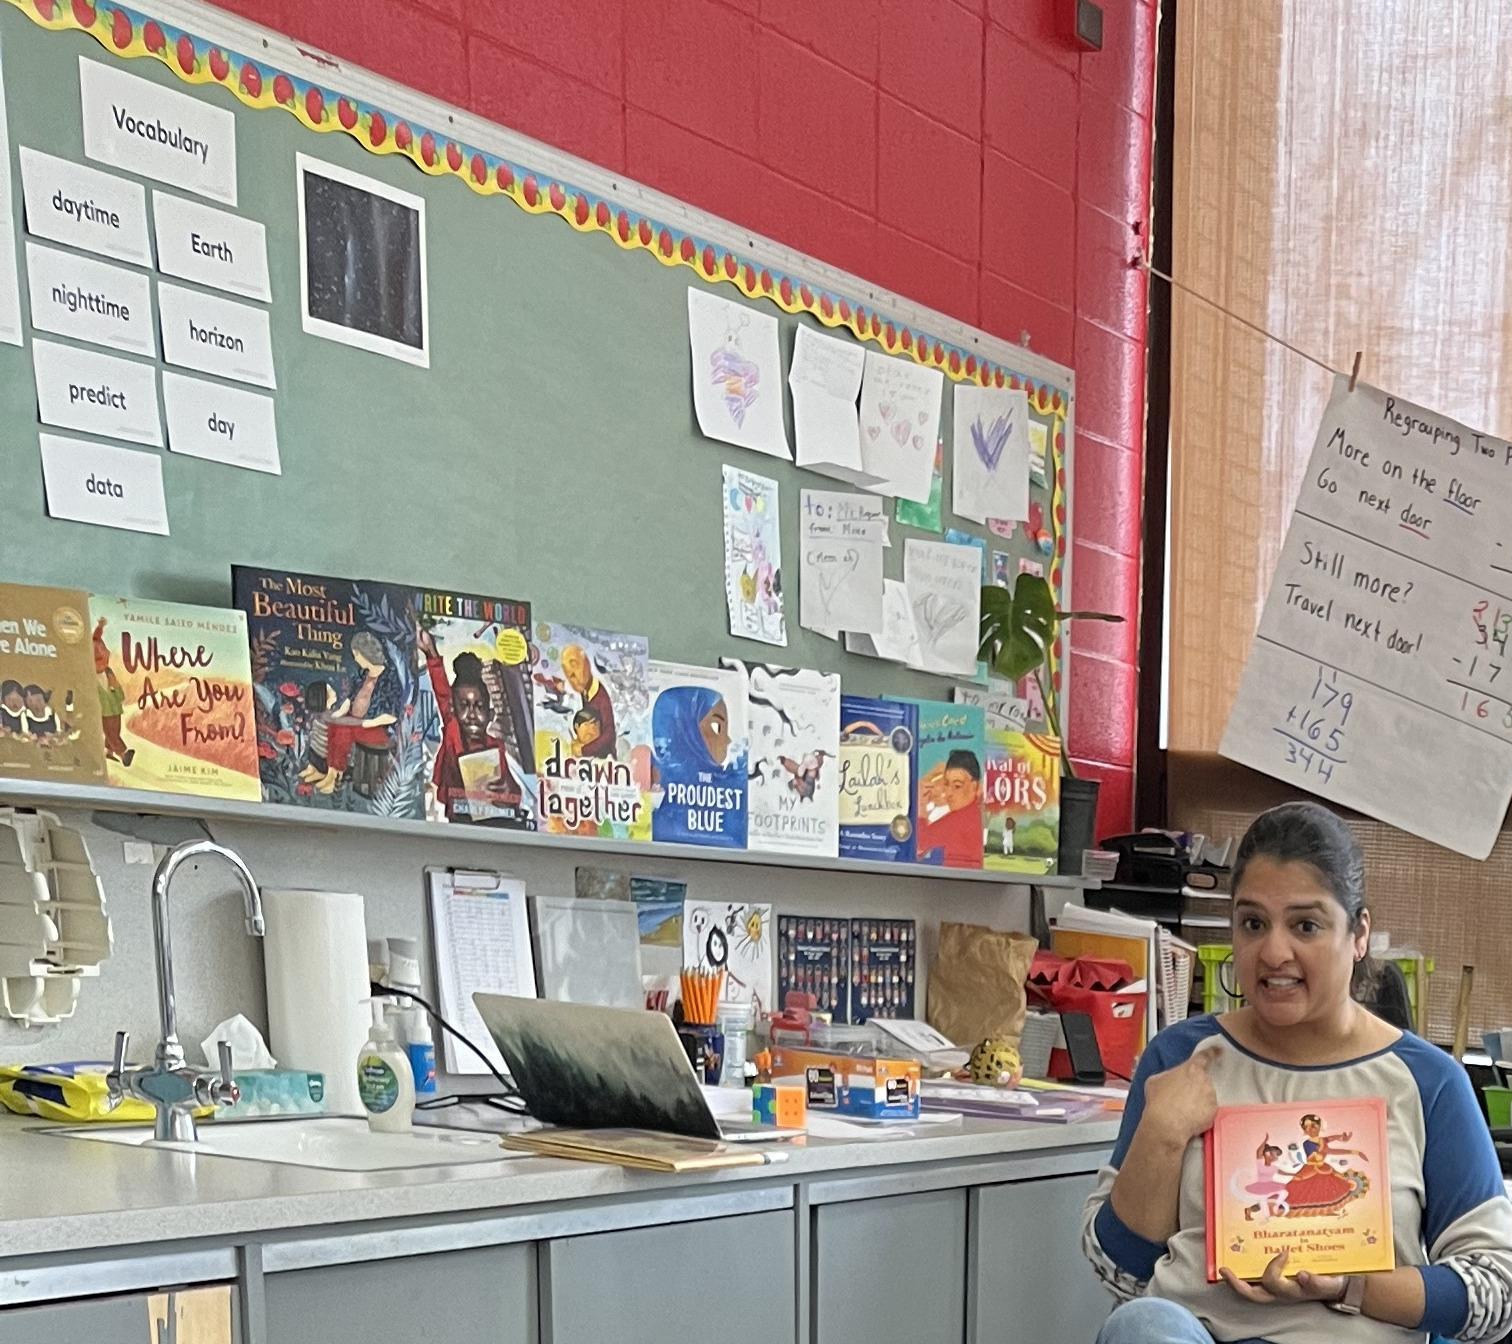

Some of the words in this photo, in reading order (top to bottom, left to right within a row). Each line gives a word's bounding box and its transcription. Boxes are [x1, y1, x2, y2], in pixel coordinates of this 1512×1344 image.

[112, 105, 209, 164] Vocabulary
[52, 190, 120, 230] daytime
[191, 234, 233, 263] Earth
[52, 285, 130, 323] nighttime
[189, 320, 244, 354] horizon
[68, 381, 127, 412] predict
[208, 413, 235, 440] day
[1384, 398, 1460, 456] Regrouping
[1472, 433, 1494, 458] Two
[1328, 428, 1370, 467] More
[1382, 461, 1402, 479] on
[1412, 469, 1436, 494] the
[1448, 478, 1481, 510] floor
[85, 474, 123, 499] data
[1318, 468, 1338, 493] Go
[1359, 490, 1390, 512] next
[1400, 504, 1432, 530] door
[259, 577, 283, 590] The
[286, 578, 327, 598] Most
[1300, 542, 1344, 579] Still
[1354, 571, 1413, 604] more?
[253, 591, 355, 625] Beautiful
[415, 593, 452, 614] WRITE
[457, 598, 480, 617] THE
[484, 601, 526, 624] WORLD
[1285, 583, 1333, 621] Travel
[1346, 613, 1381, 642] next
[1387, 634, 1423, 654] door!
[23, 618, 47, 637] We
[296, 624, 343, 648] Thing
[14, 638, 58, 658] Alone
[122, 632, 213, 673] Where
[138, 677, 186, 710] Are
[189, 677, 244, 713] You
[180, 712, 245, 745] From?
[200, 766, 218, 775] KIM
[544, 738, 630, 785] drawn
[839, 753, 900, 794] Lailah's
[538, 780, 641, 828] together
[668, 783, 742, 810] PROUDEST
[779, 796, 796, 810] MY
[854, 790, 903, 817] Lunchbox
[984, 771, 1047, 811] LORS
[687, 809, 724, 833] BLUE
[748, 812, 826, 834] FOOTPRINTS
[1253, 1227, 1355, 1239] Bharatanatyam
[1264, 1244, 1303, 1254] Ballet
[1307, 1243, 1345, 1252] Shoes
